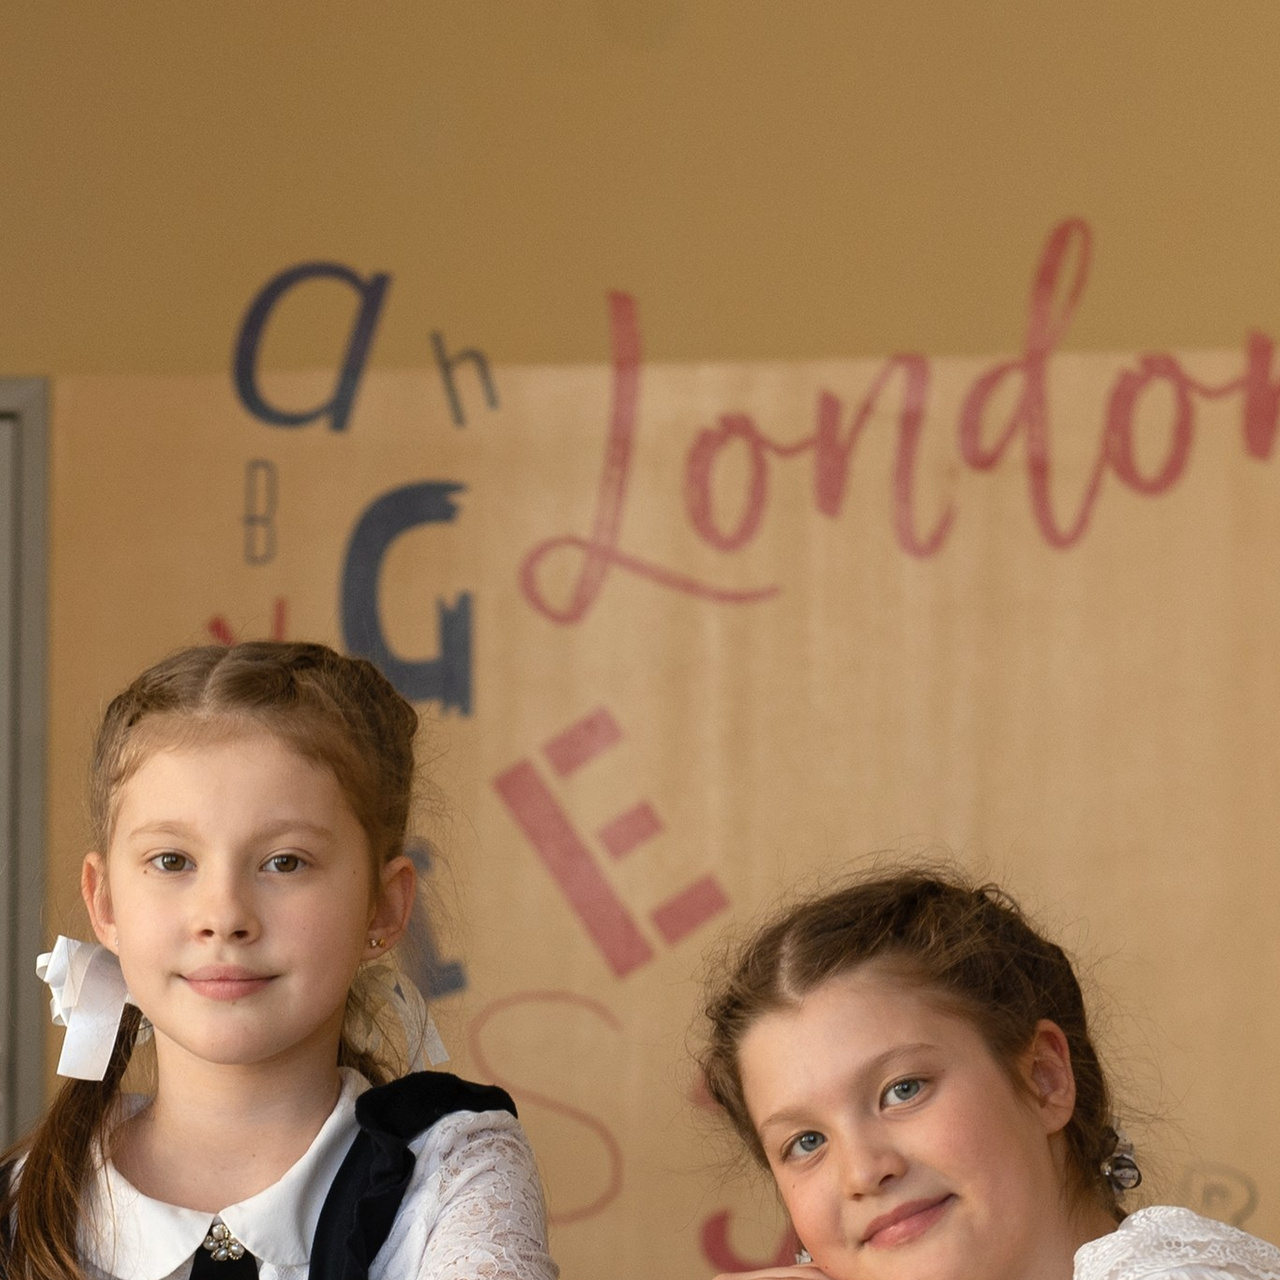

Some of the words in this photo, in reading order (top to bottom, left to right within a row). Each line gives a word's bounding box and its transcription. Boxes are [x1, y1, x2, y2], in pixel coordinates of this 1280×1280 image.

[231, 260, 392, 433] a
[431, 330, 498, 428] h
[339, 480, 473, 718] G
[492, 706, 732, 980] E
